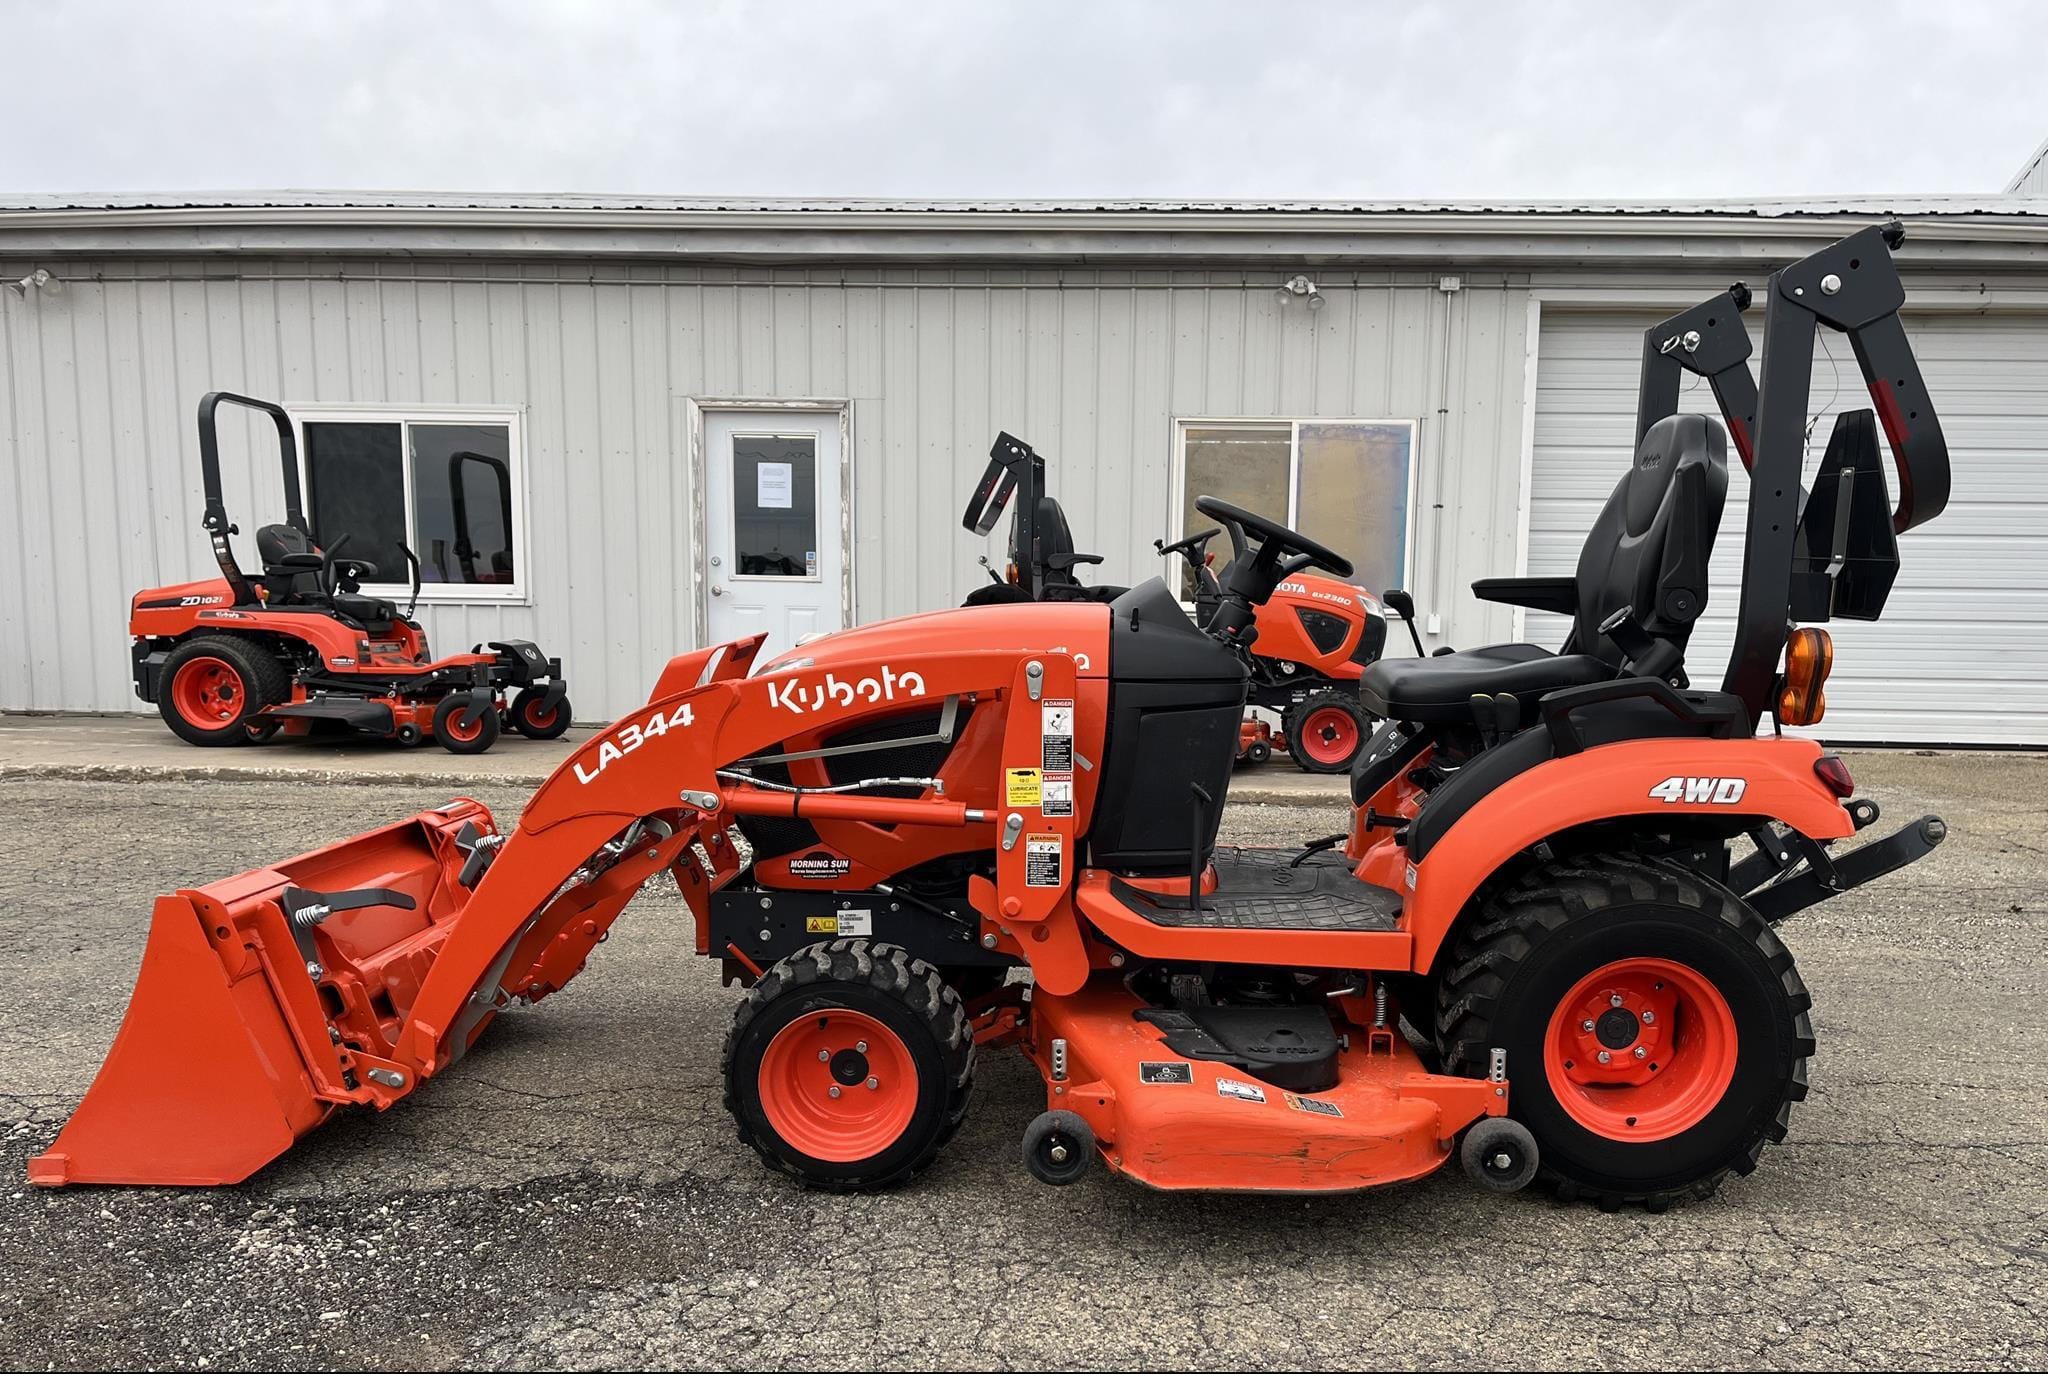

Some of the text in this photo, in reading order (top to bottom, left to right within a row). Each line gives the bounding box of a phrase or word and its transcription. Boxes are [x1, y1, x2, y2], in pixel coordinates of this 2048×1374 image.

[768, 665, 926, 714] Kubota
[573, 703, 695, 784] LA344
[1648, 776, 1747, 804] 4WD
[790, 860, 849, 868] MORNING SUN
